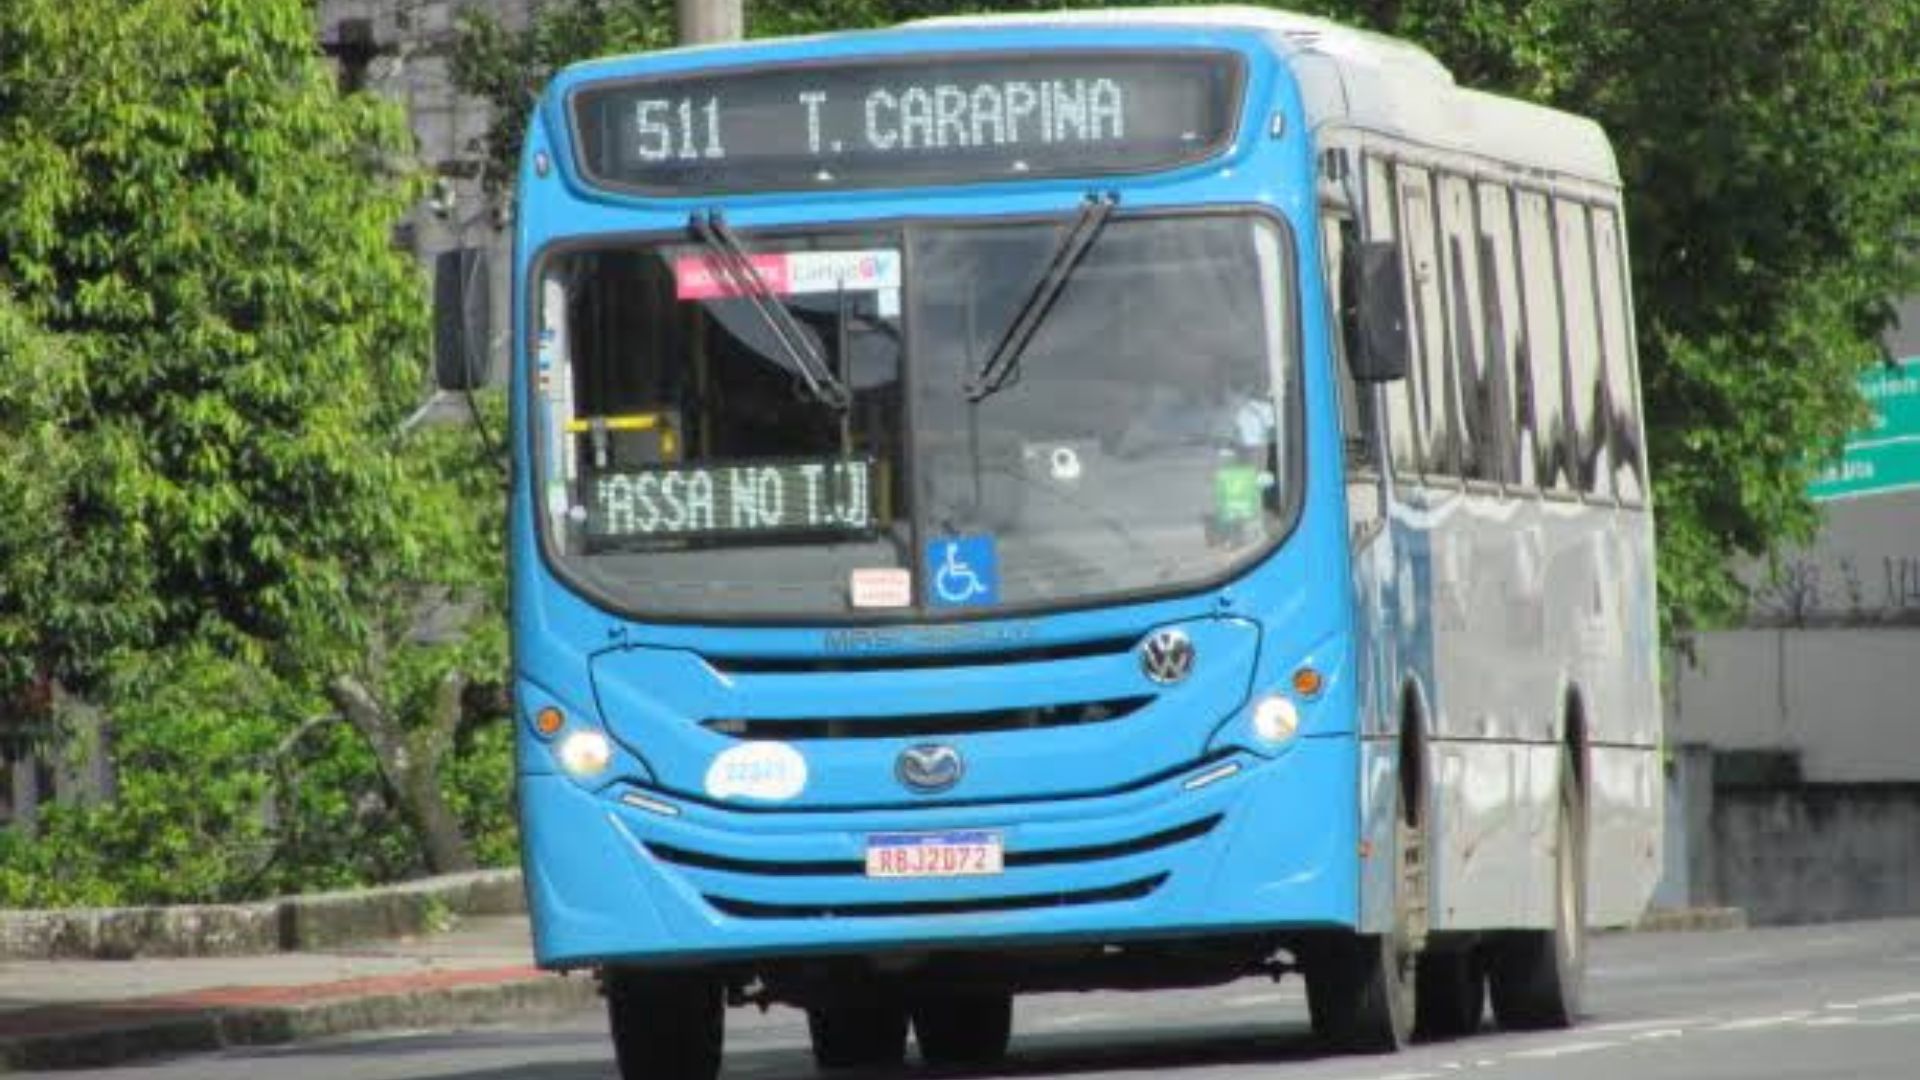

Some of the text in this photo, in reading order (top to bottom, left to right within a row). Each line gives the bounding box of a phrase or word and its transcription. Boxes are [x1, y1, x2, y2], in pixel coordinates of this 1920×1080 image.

[636, 79, 1125, 160] 511 T. CARAPINA
[730, 466, 783, 528] NO
[879, 846, 986, 873] RBJ2D72
